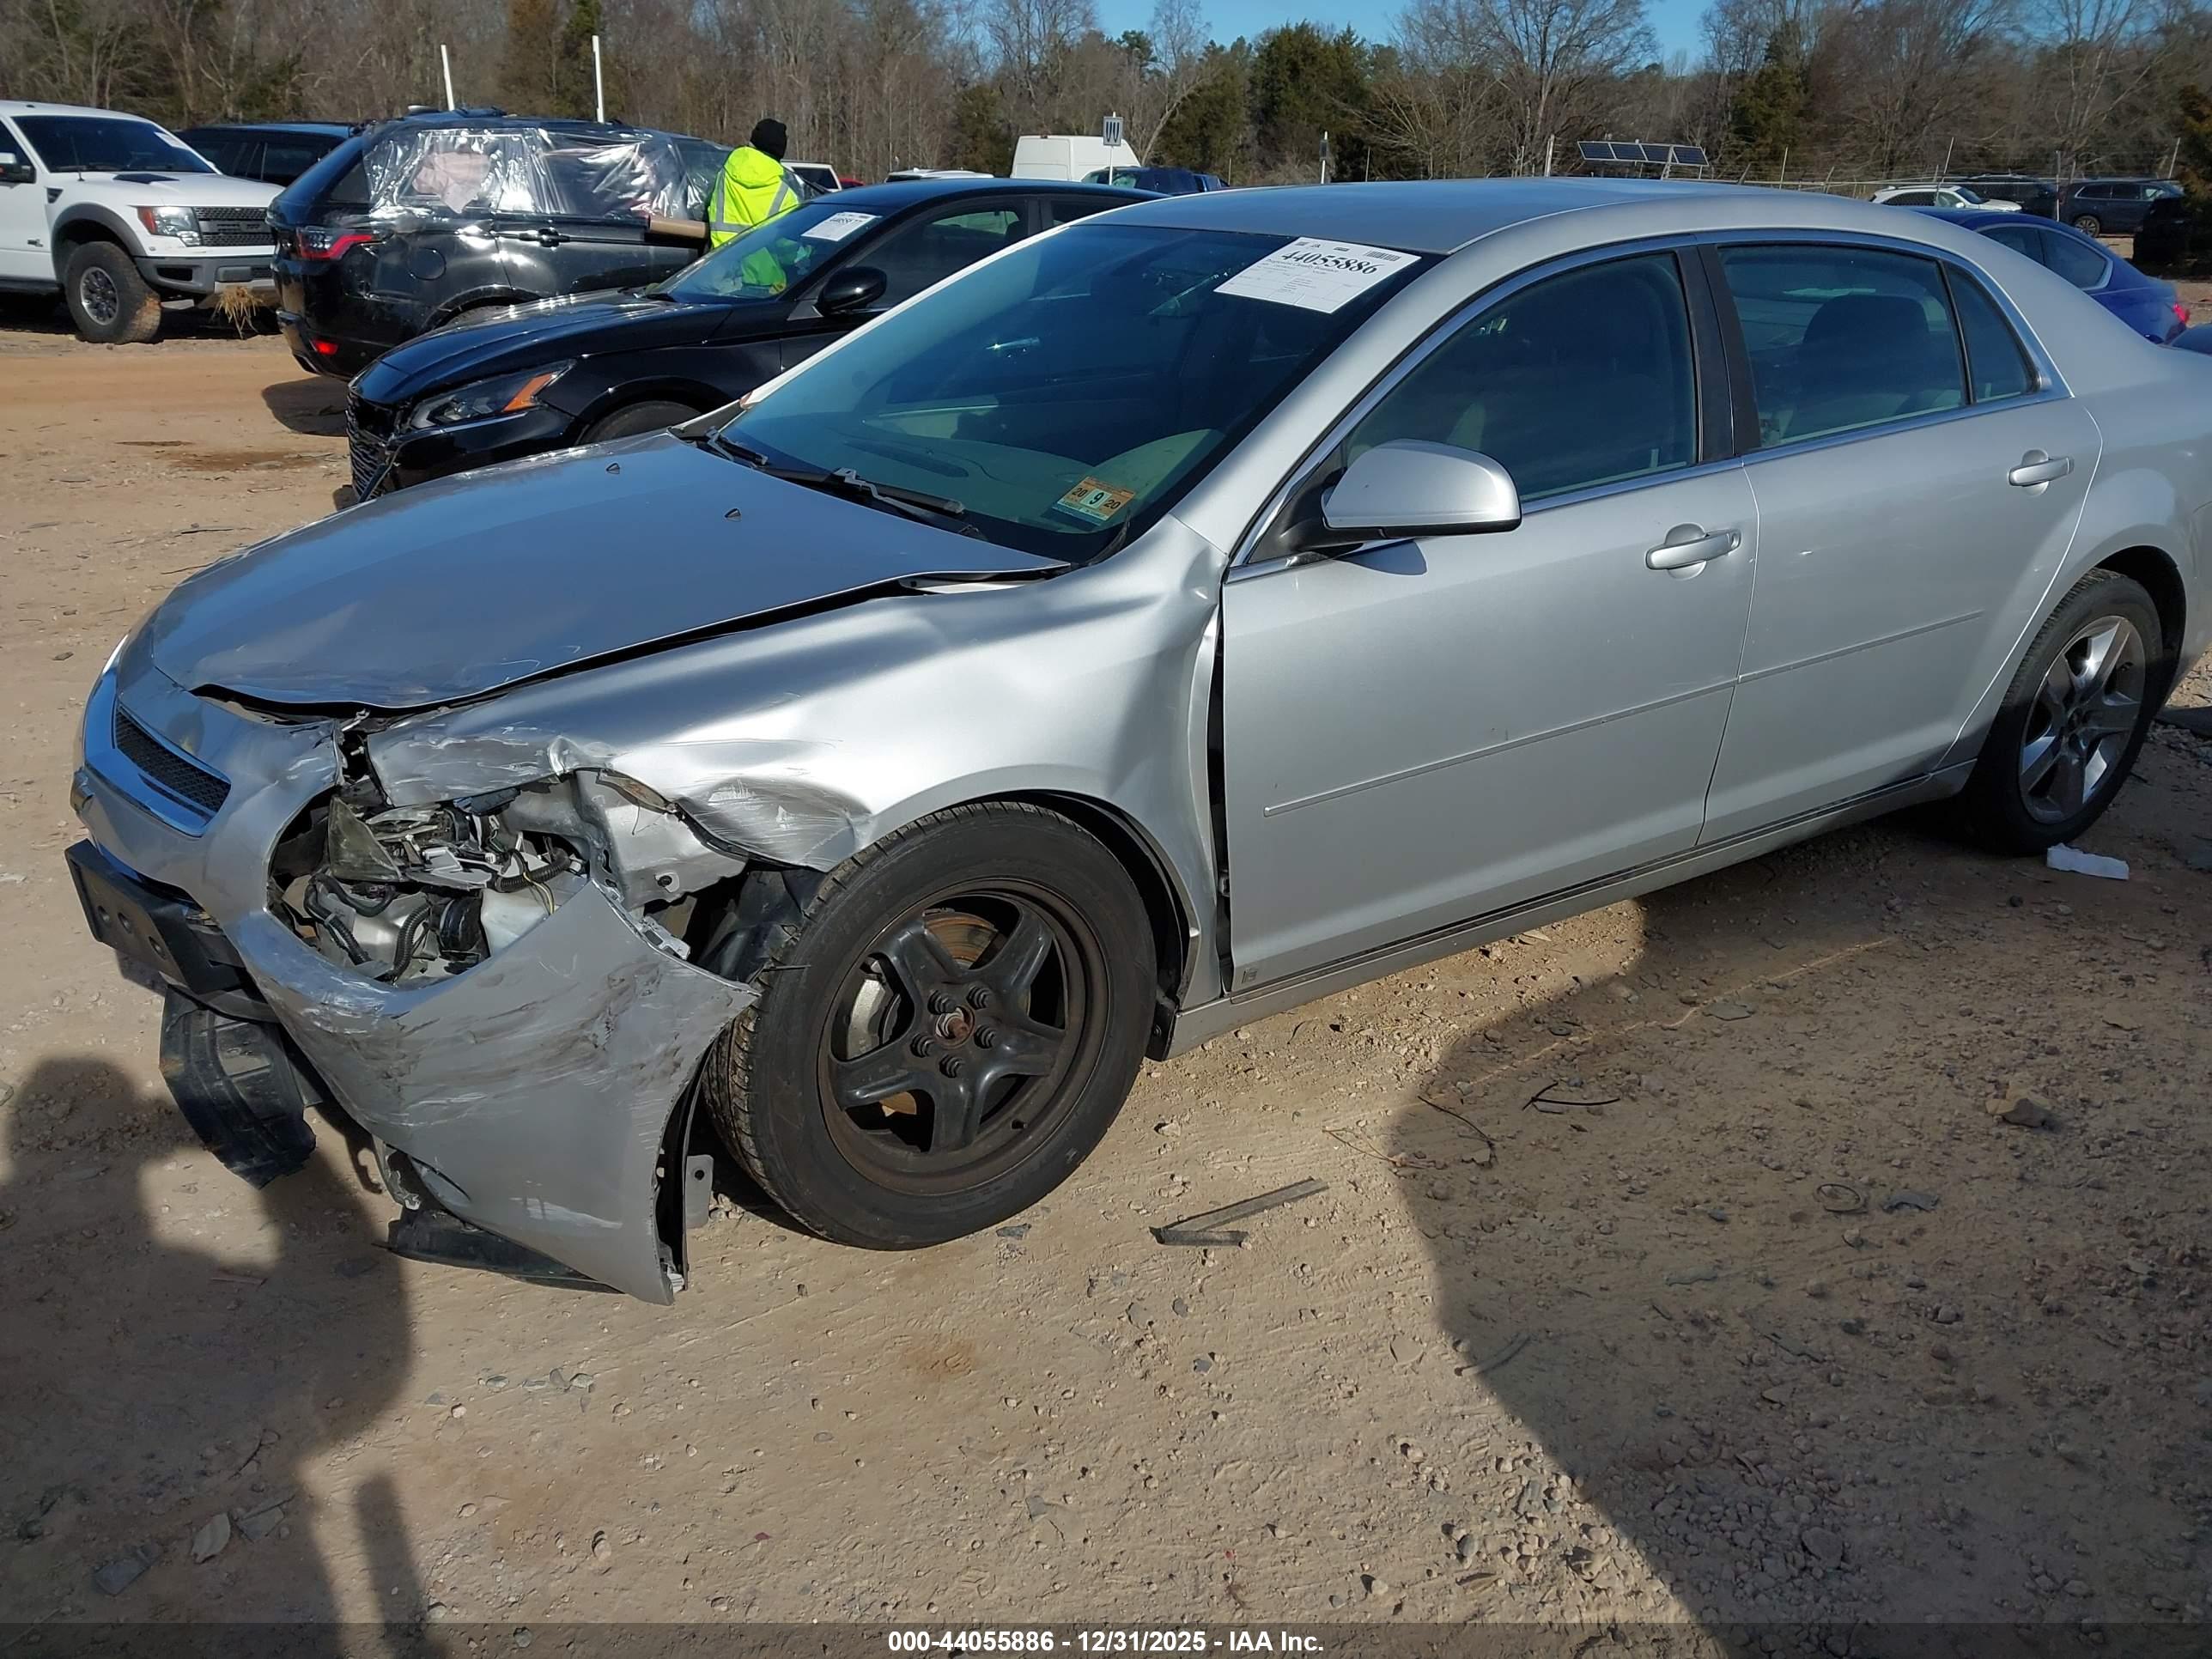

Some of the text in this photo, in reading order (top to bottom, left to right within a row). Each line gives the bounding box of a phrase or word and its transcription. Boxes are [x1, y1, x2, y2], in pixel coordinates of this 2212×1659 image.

[1281, 250, 1385, 275] 44055886
[1072, 487, 1088, 498] 20
[1089, 491, 1105, 505] 9
[1104, 500, 1121, 509] 20
